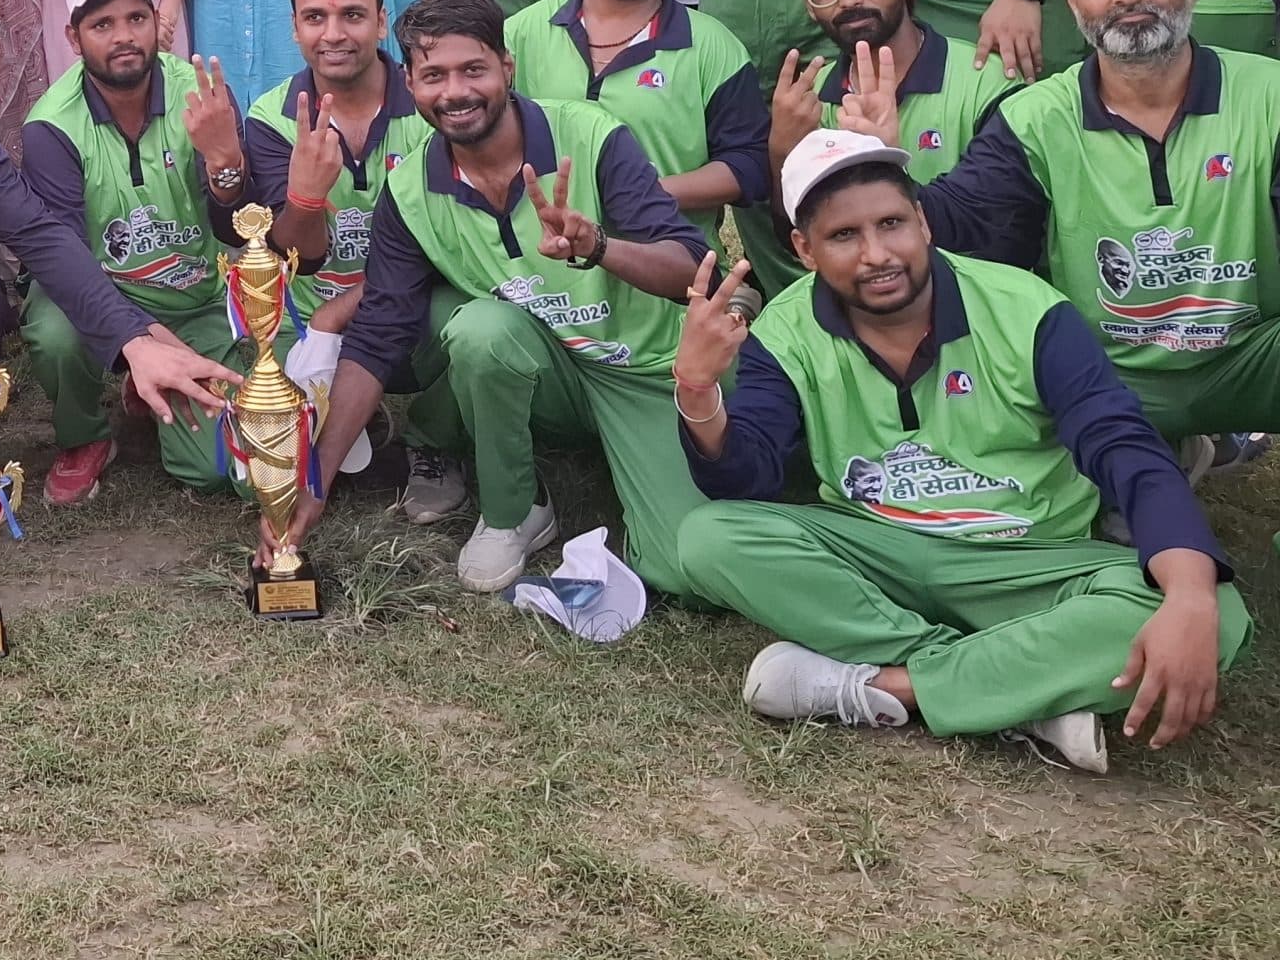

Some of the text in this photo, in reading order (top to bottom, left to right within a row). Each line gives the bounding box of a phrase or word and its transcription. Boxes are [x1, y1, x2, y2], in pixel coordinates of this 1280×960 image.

[339, 242, 356, 258] ही
[1142, 269, 1165, 287] ही
[571, 302, 609, 323] 2024
[892, 474, 968, 499] ही सेवा
